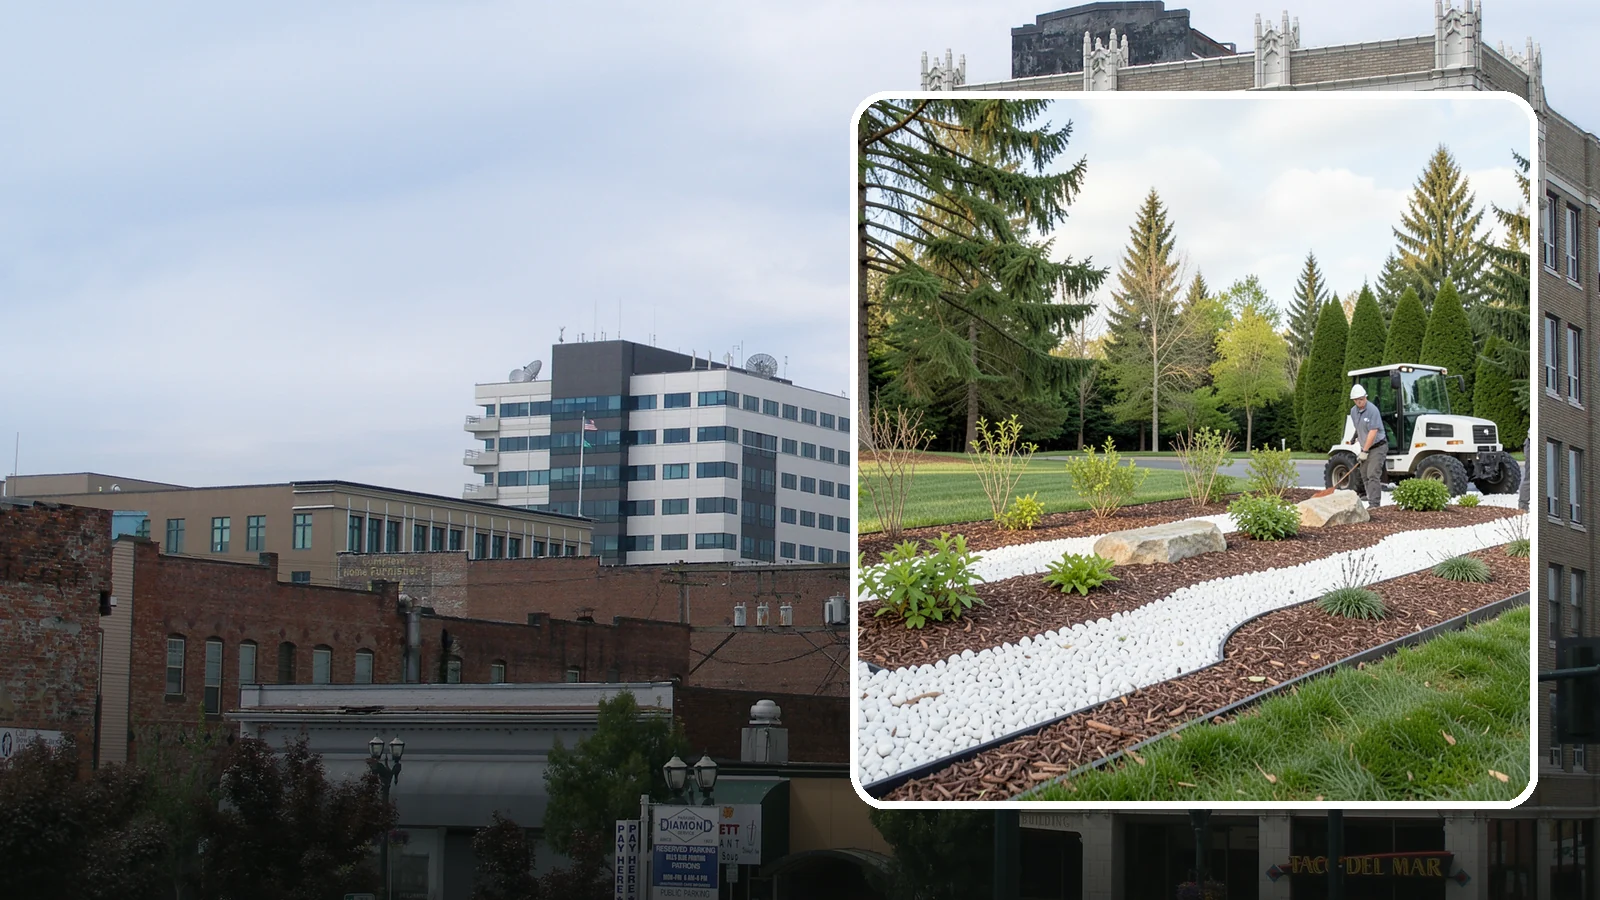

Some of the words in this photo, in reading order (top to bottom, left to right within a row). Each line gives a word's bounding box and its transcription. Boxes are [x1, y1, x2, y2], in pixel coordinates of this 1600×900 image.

[370, 566, 427, 576] Furnishers
[660, 818, 713, 832] DIAMOND
[1022, 815, 1070, 828] BUILDING
[617, 825, 625, 852] PAY
[628, 824, 637, 852] PAY
[655, 845, 688, 853] RESERVED
[690, 846, 716, 854] PARKING
[722, 851, 739, 862] Soup
[671, 862, 701, 870] PATRONS
[1289, 855, 1329, 874] TAC
[1346, 856, 1385, 875] DEL
[1392, 857, 1442, 876] MAR
[617, 856, 625, 893] HERE
[628, 856, 636, 893] HERE
[660, 888, 682, 897] PUBLIC
[683, 889, 710, 898] PARKING
